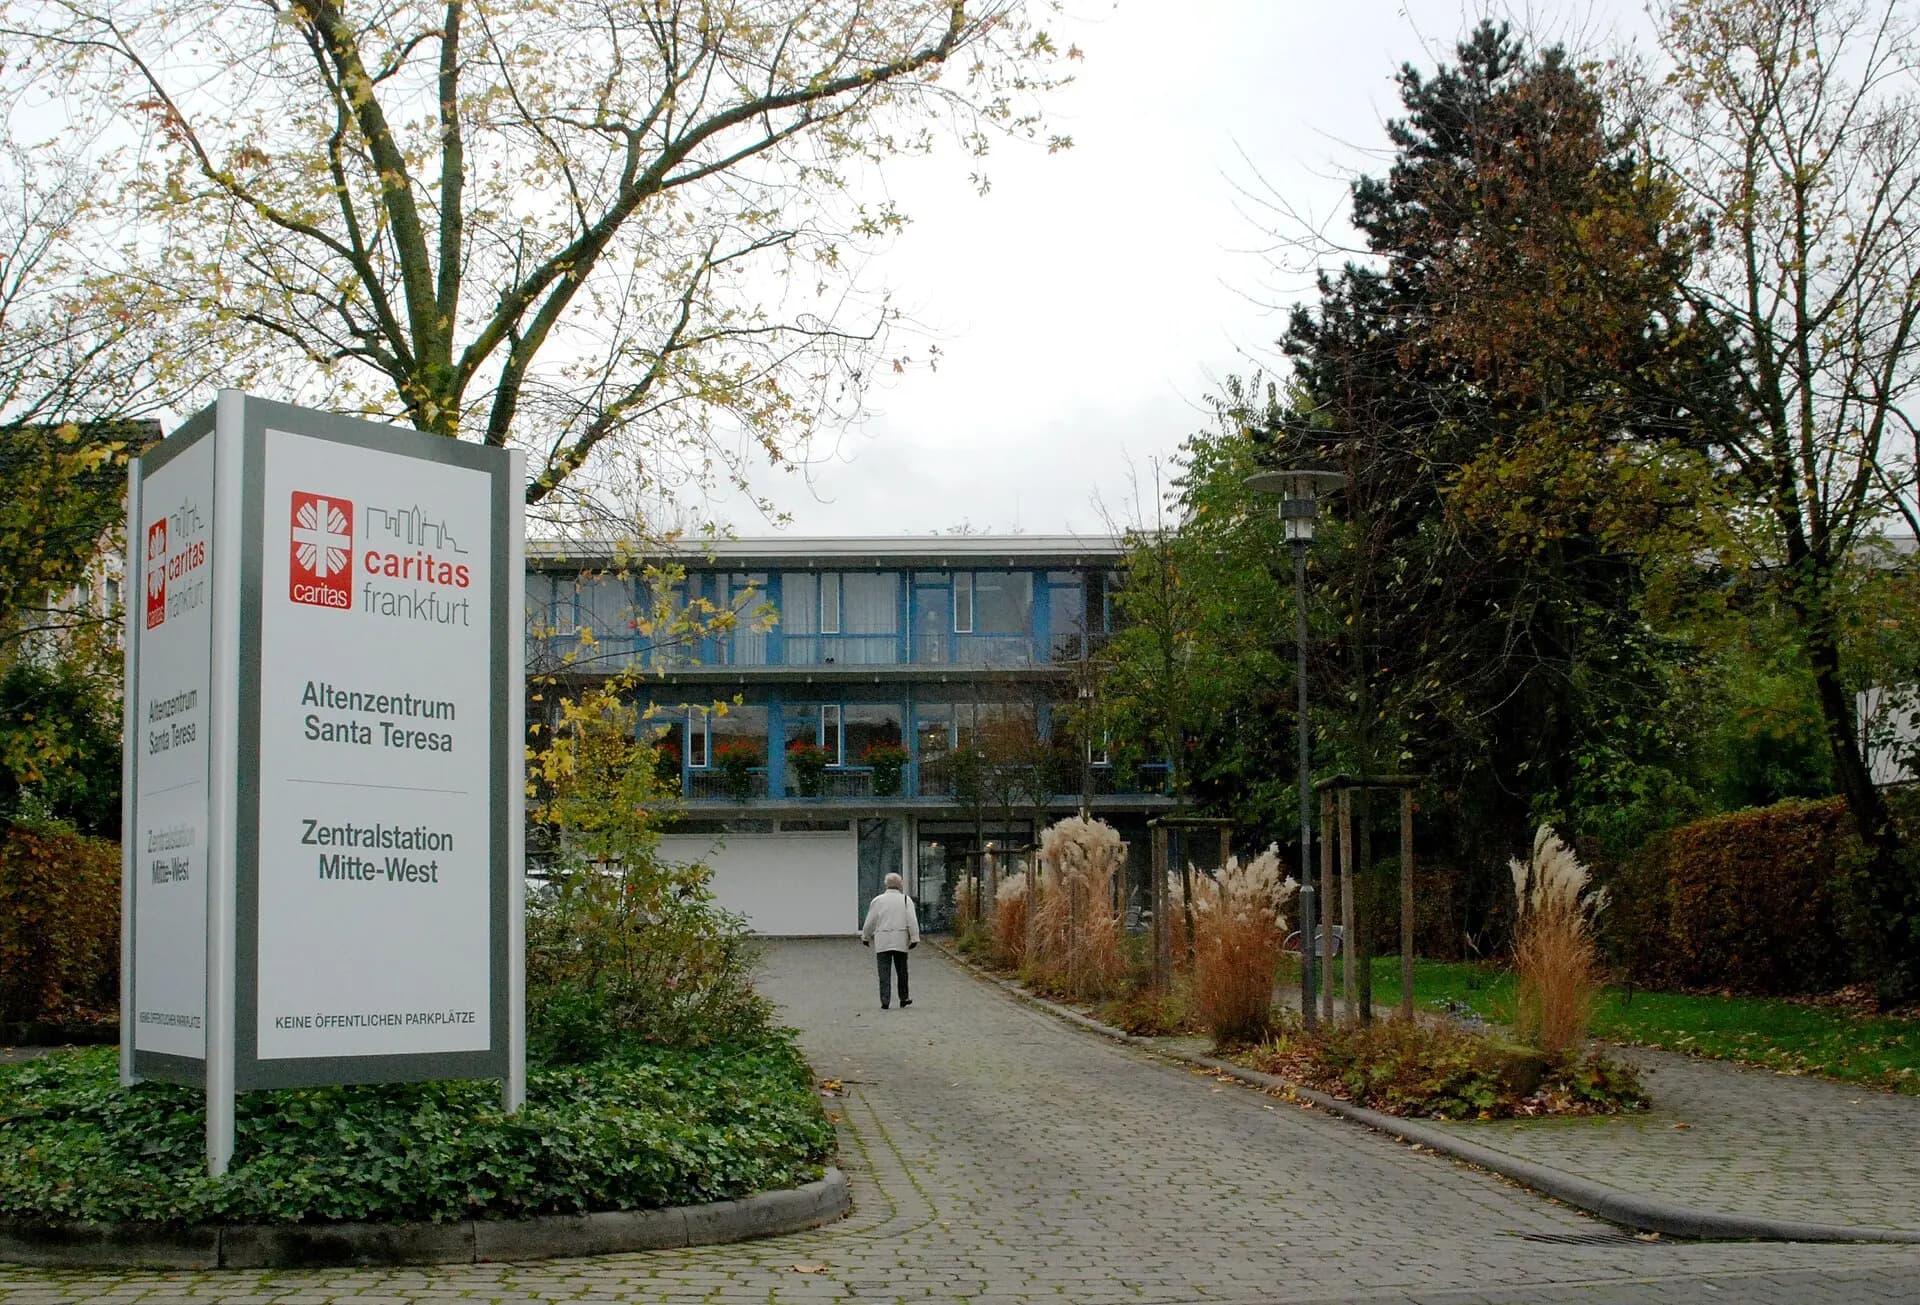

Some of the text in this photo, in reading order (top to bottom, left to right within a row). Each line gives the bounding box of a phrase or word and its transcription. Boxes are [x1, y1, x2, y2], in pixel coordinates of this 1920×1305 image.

[168, 540, 205, 581] caritas
[364, 550, 470, 588] caritas
[294, 582, 348, 607] caritas
[363, 581, 470, 627] frankfurt
[301, 680, 456, 721] Altenzentrum
[149, 722, 196, 755] Santa Teresa
[304, 713, 453, 752] Santa Teresa
[301, 818, 454, 852] Zentralstation
[319, 853, 438, 883] Mitte-West
[275, 1009, 476, 1030] KEINE ÖFFENTLICHEN PARKPLÄTZE
